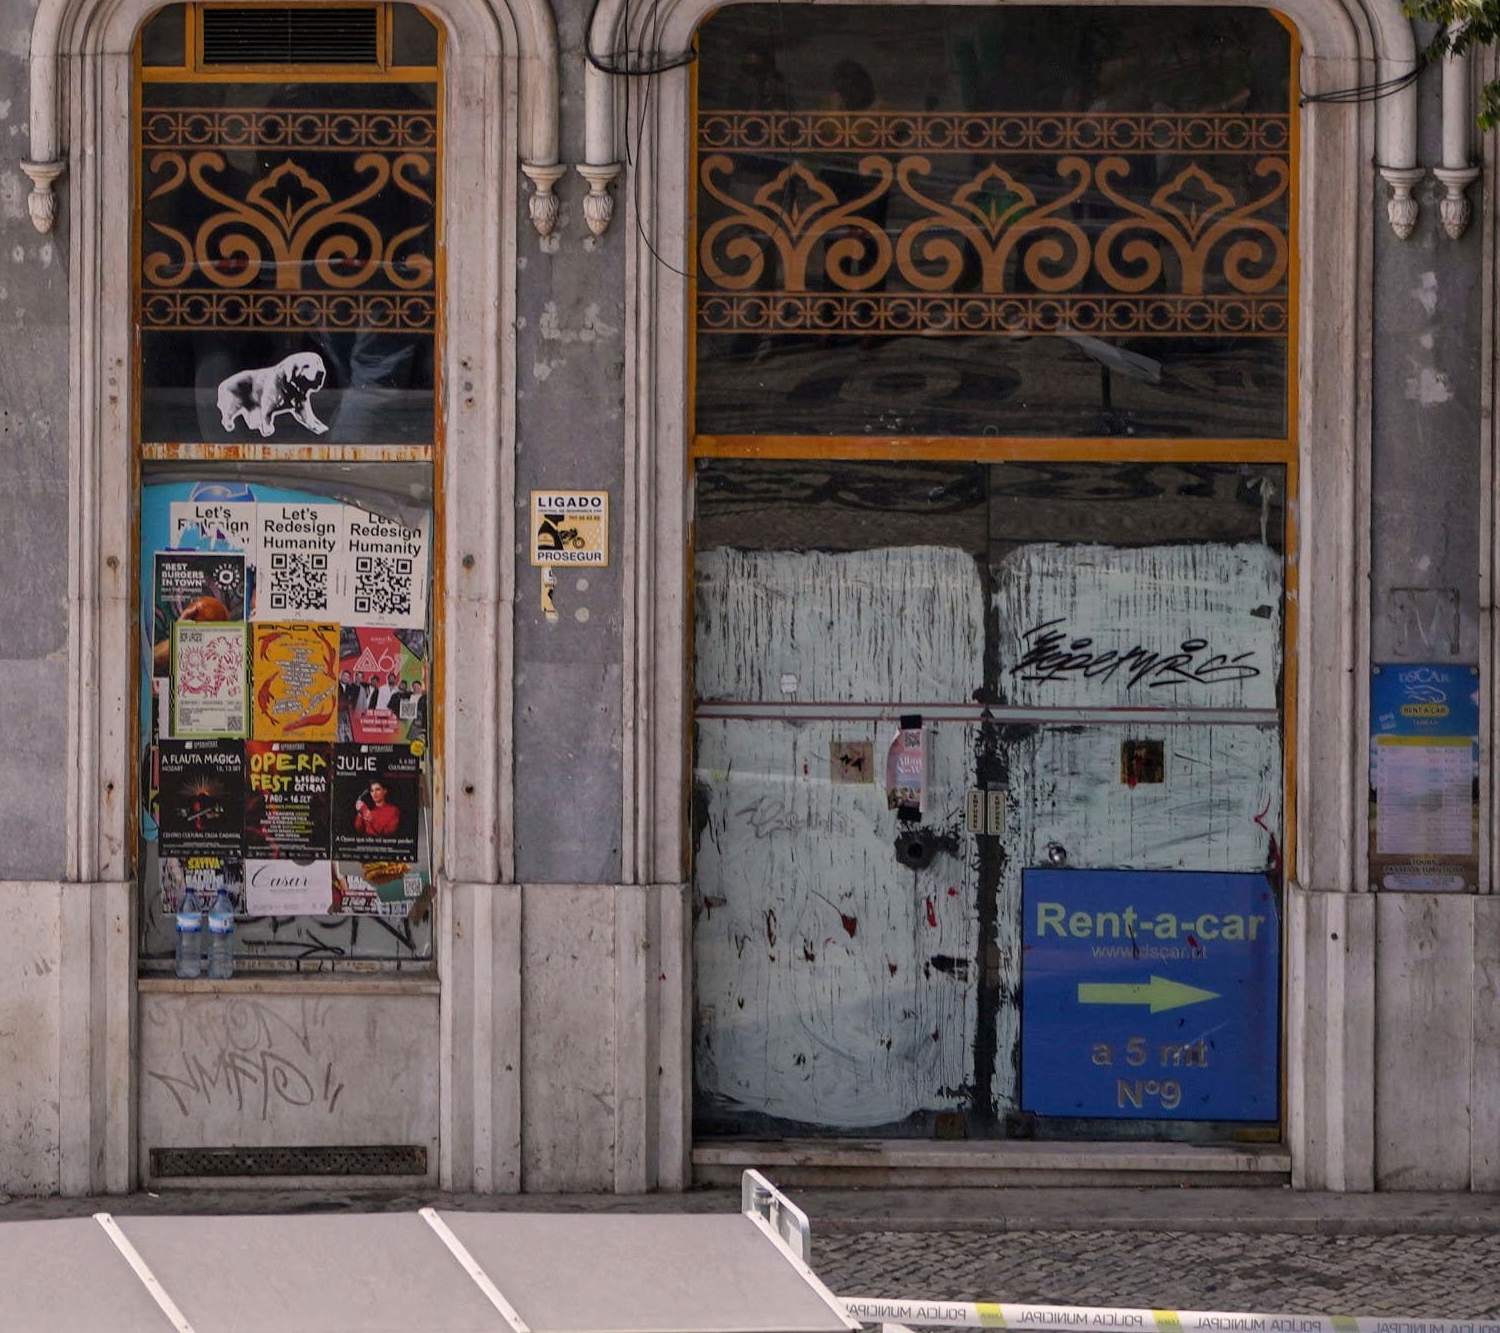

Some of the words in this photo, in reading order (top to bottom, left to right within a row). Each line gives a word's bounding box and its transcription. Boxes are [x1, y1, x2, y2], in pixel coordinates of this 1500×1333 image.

[538, 496, 602, 508] LIGADO
[195, 505, 232, 519] Let's
[282, 507, 318, 521] Let's
[264, 520, 336, 537] Redesign
[350, 522, 422, 541] Redesign
[263, 536, 336, 552] Humanity
[349, 538, 422, 557] Humanity
[538, 551, 602, 562] PROSEGUR
[161, 570, 204, 579] BURGERS
[161, 578, 173, 587] IN
[161, 754, 169, 764] A
[170, 754, 203, 765] FLAUTA
[204, 752, 241, 765] MÁGICA
[250, 752, 327, 773] OPERA
[336, 755, 377, 771] JULIE
[250, 773, 292, 793] FEST
[294, 774, 326, 783] LISBOA
[294, 783, 326, 793] OEIRAS
[1036, 902, 1265, 940] Rent-a-car
[1091, 1041, 1112, 1067] a
[1126, 1037, 1147, 1067] 5
[1160, 1038, 1209, 1068] mt
[1117, 1079, 1182, 1110] Nº9
